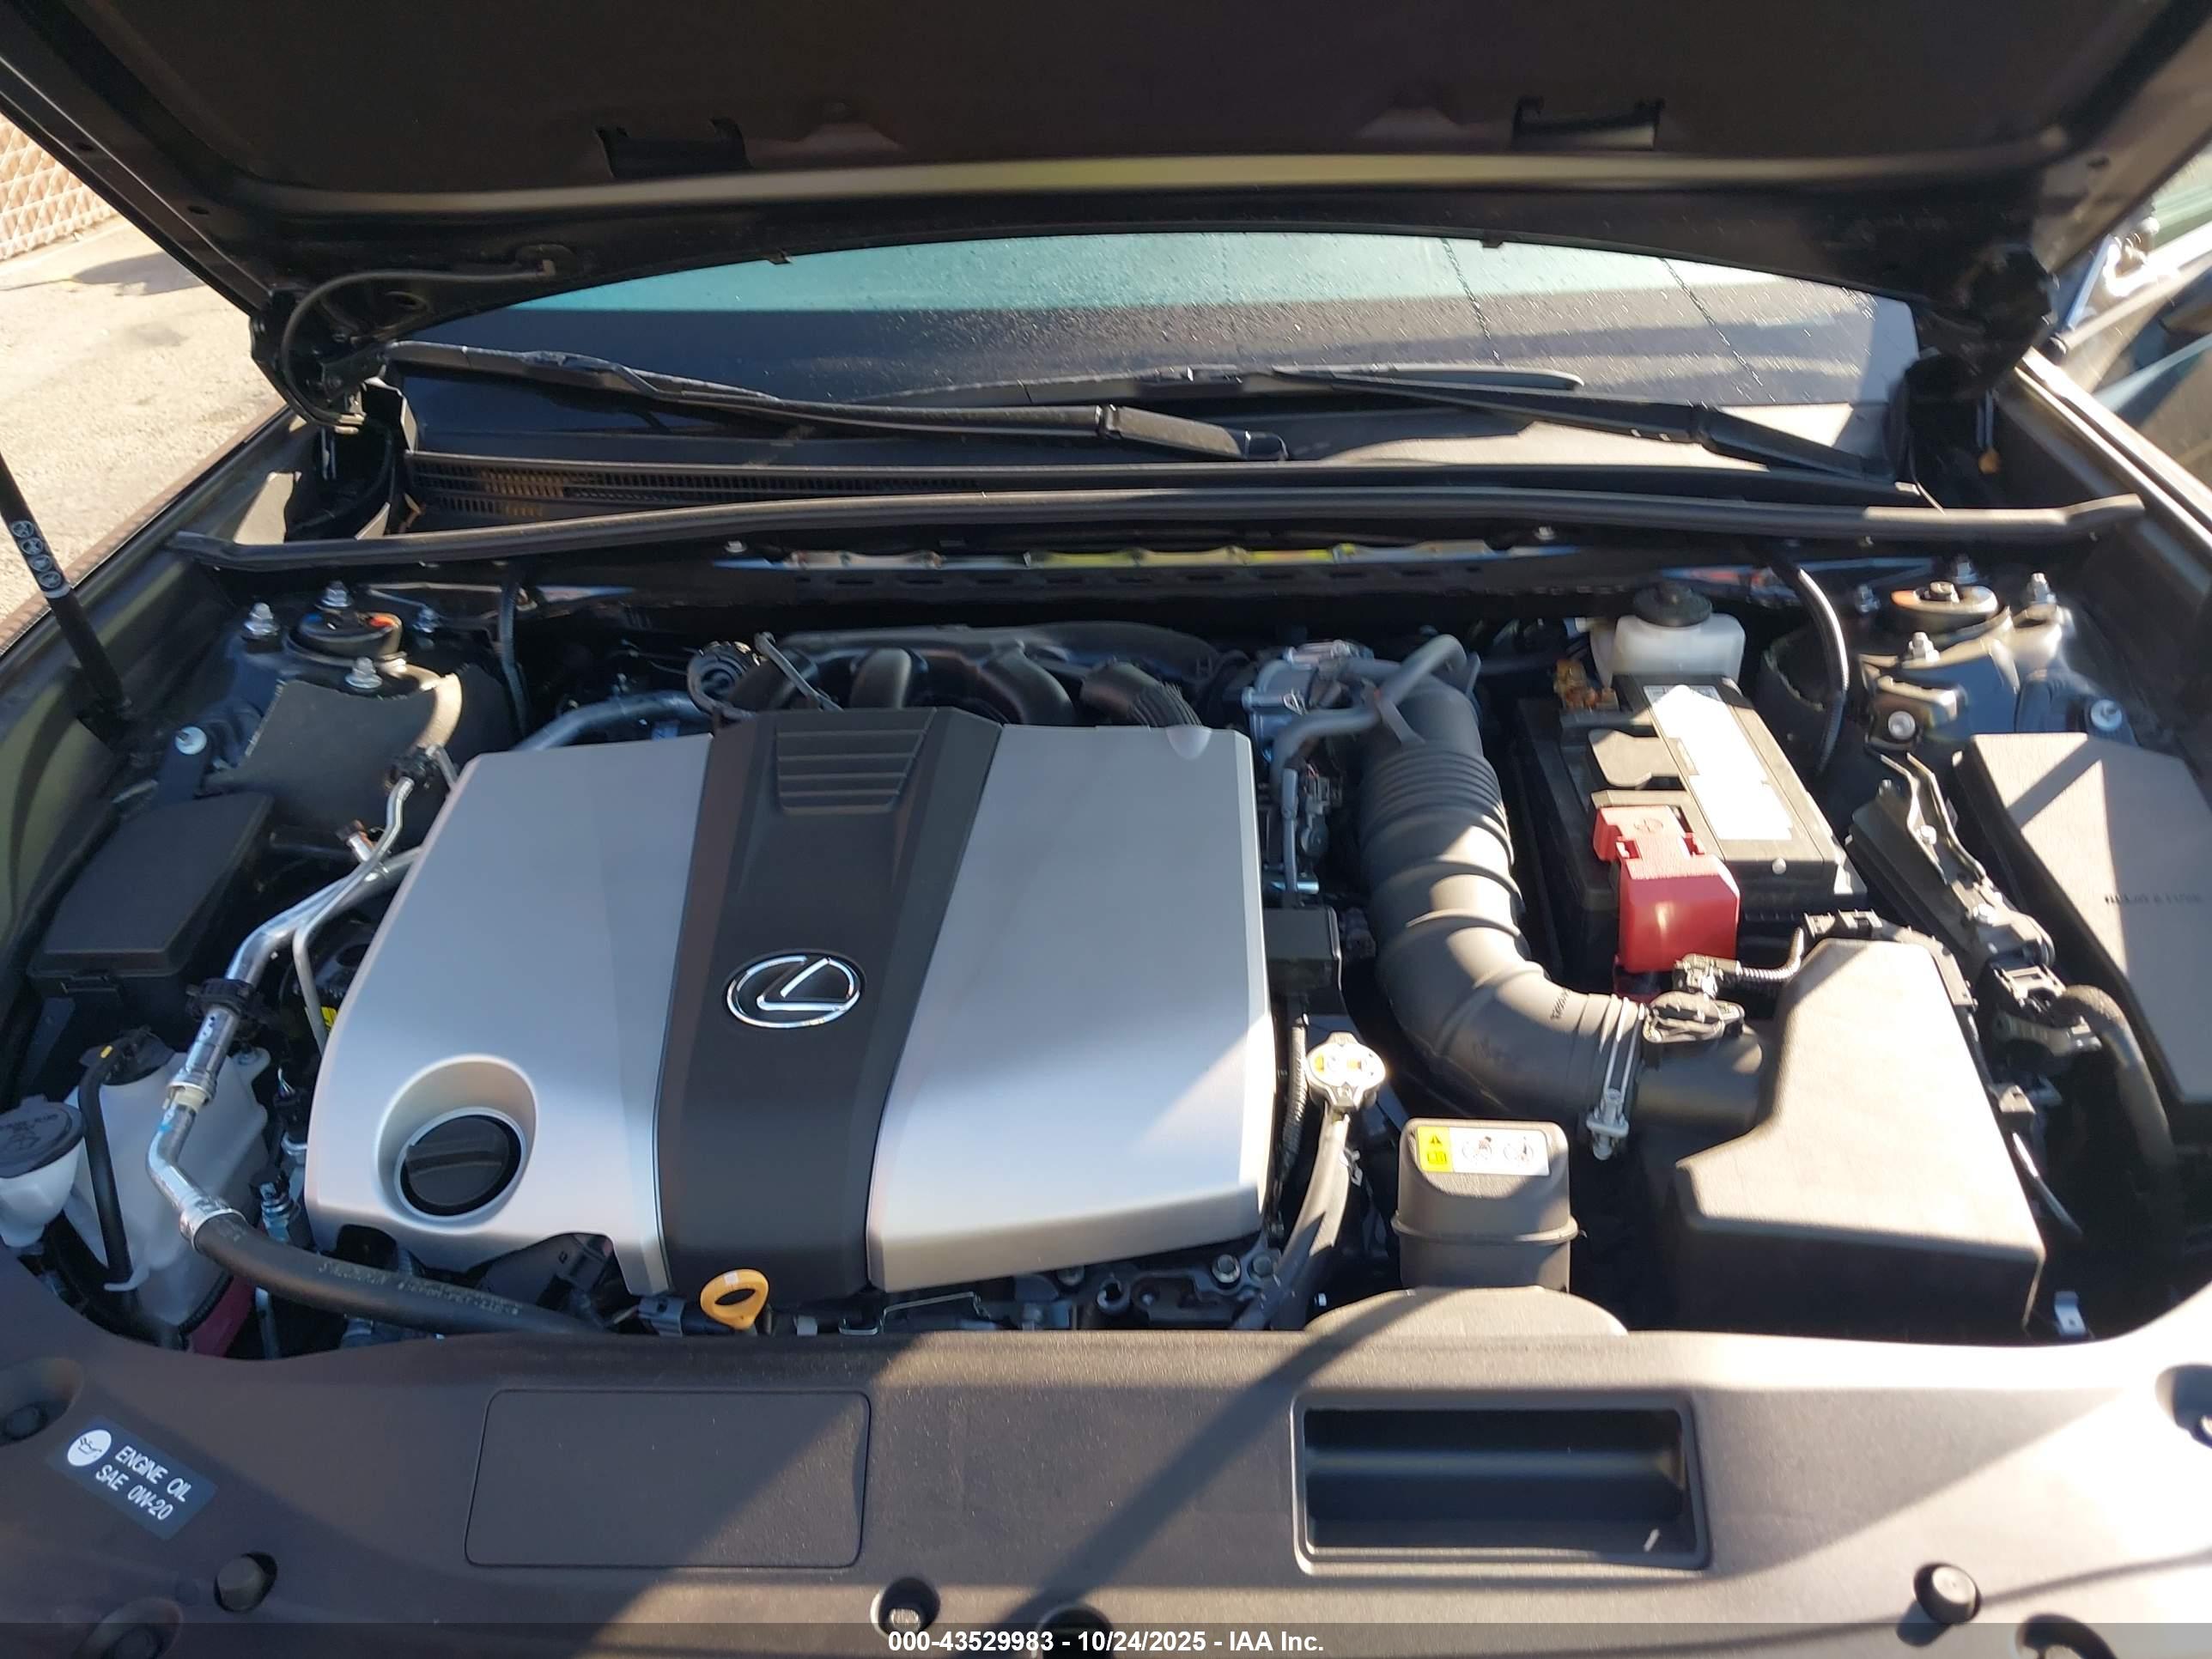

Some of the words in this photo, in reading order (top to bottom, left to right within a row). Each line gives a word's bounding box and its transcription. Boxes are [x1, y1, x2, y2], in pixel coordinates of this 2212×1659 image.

[95, 1464, 130, 1491] SAE
[127, 1485, 173, 1520] 0W-20
[115, 1445, 168, 1485] ENGINE
[167, 1478, 191, 1502] OIL
